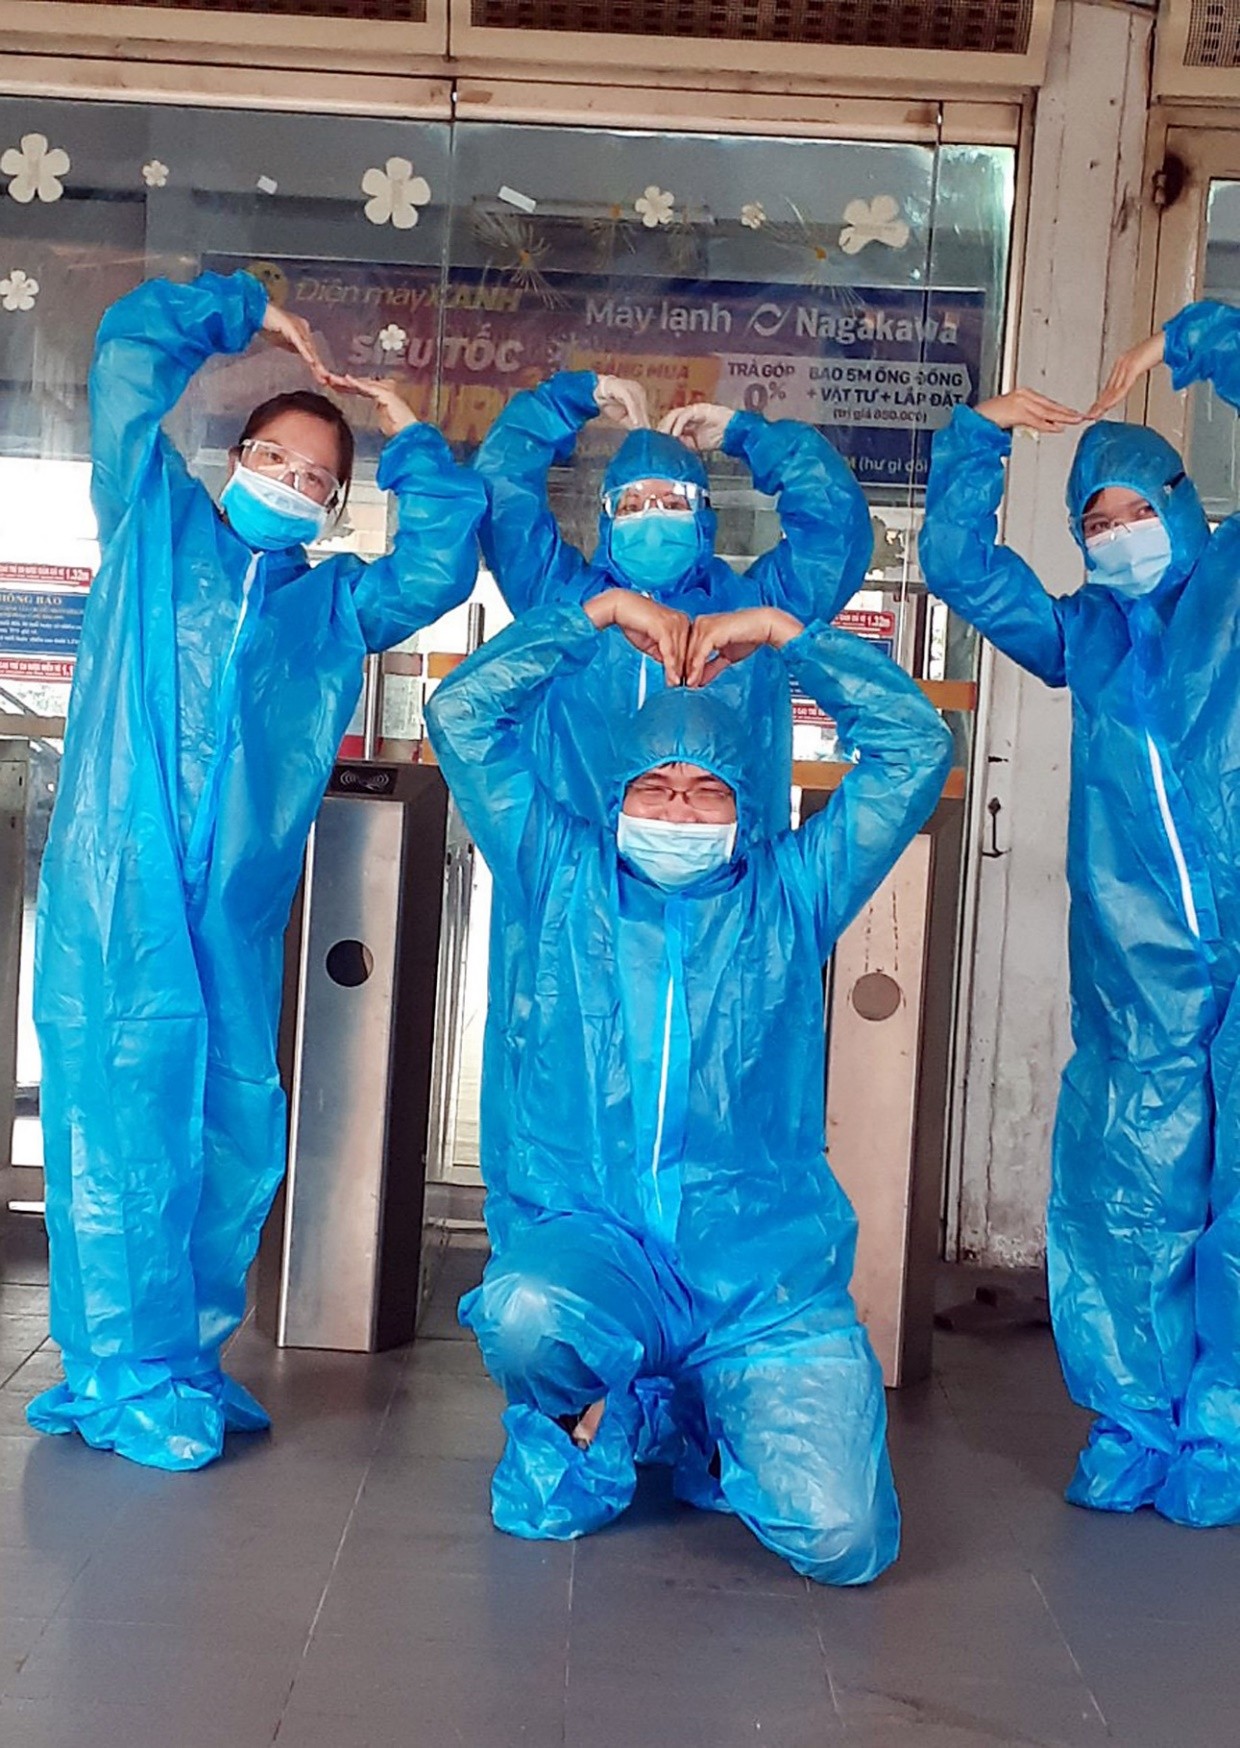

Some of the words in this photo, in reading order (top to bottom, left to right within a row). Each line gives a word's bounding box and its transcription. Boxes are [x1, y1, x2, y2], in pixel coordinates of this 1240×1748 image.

[585, 297, 654, 335] Máy
[661, 301, 732, 338] lạnh
[796, 306, 959, 345] Nagakawa
[441, 322, 525, 373] TỐC
[727, 359, 759, 378] TRẢ
[761, 361, 796, 379] GÓP
[808, 366, 844, 382] BAO
[846, 367, 872, 383] 5M
[743, 380, 787, 413] 0%
[854, 388, 880, 404] TƯ
